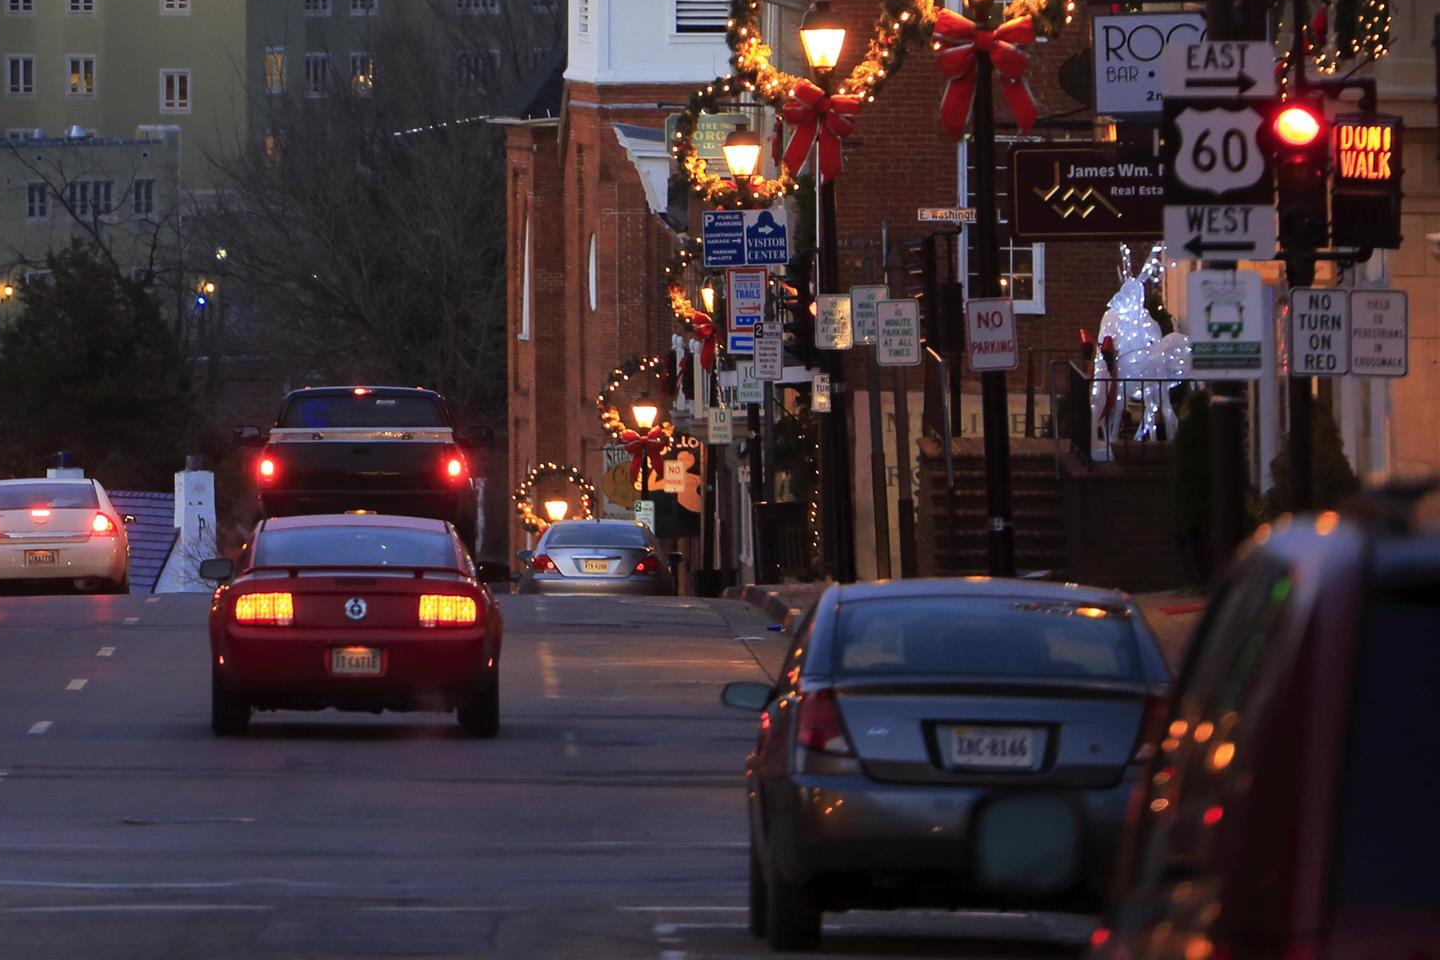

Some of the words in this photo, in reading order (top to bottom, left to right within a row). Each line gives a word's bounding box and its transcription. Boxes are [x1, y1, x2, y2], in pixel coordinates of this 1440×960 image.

[1186, 43, 1250, 70] EAST
[1106, 66, 1139, 83] BAR
[1191, 127, 1250, 174] 60
[1067, 163, 1115, 179] James
[1118, 164, 1153, 178] Wm.
[1340, 150, 1392, 179] WALK
[1111, 185, 1135, 196] Real
[1139, 186, 1164, 196] Esta
[704, 214, 715, 227] P
[931, 209, 976, 221] Washingt
[1186, 205, 1254, 234] WEST
[747, 238, 786, 248] VISITOR
[748, 250, 786, 261] CENTER
[736, 289, 761, 299] TRAILS
[1309, 294, 1332, 311] NO
[1367, 300, 1391, 310] YIELD
[884, 318, 912, 327] MINUTE
[977, 311, 1003, 329] NO
[1298, 313, 1343, 330] TURN
[755, 324, 763, 337] 2
[882, 328, 914, 336] PARKING
[884, 339, 893, 347] AT
[971, 341, 1013, 355] PARKING
[1309, 334, 1332, 351] ON
[1304, 353, 1337, 371] RED
[714, 411, 726, 423] 10
[668, 466, 681, 474] NO
